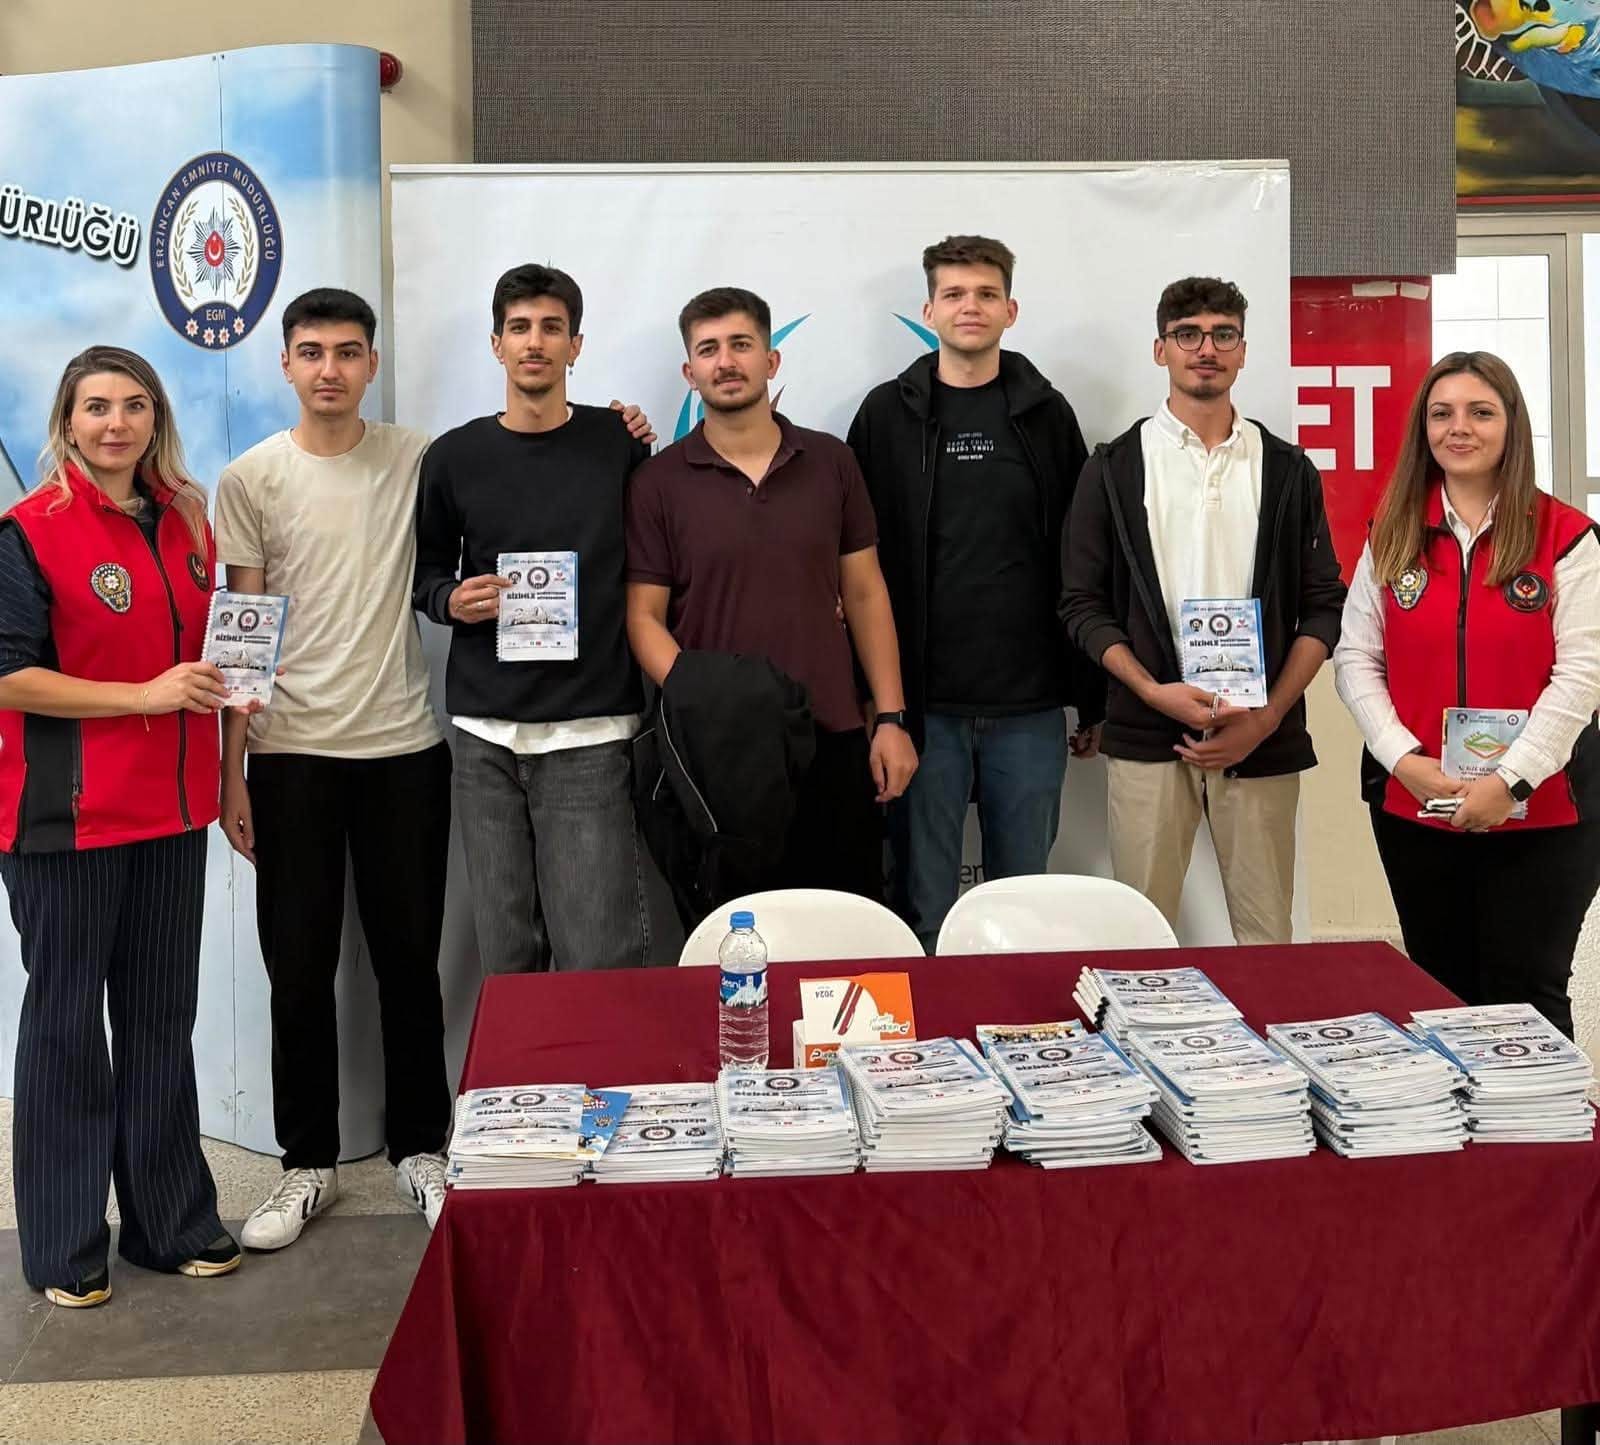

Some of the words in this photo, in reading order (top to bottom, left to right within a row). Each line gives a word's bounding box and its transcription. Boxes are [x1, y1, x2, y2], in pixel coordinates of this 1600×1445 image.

[156, 188, 181, 268] ERZİNCAN
[183, 161, 229, 186] EMNİYET
[233, 167, 277, 260] MÜDÜRLÜĞÜ
[206, 309, 226, 321] EGM
[1290, 365, 1392, 471] ET
